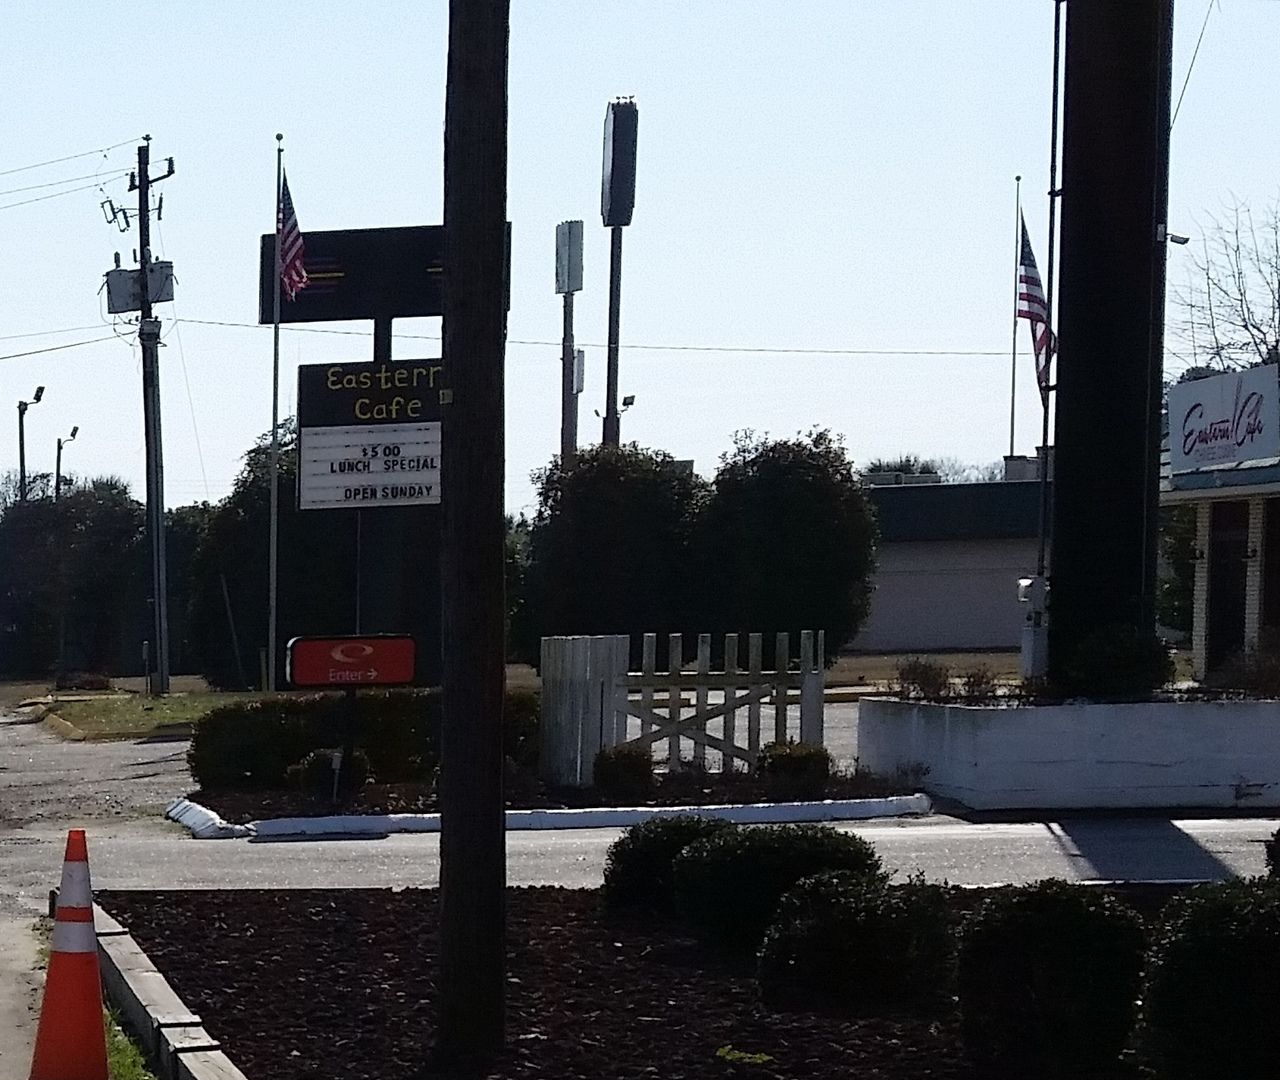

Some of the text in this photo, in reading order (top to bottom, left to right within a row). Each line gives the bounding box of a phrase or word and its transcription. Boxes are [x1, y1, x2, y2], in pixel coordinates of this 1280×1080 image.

[355, 397, 422, 419] Cafe
[330, 457, 438, 474] LUNCH SPECIAL
[344, 485, 433, 500] OPEN SUNDAY
[329, 669, 364, 681] Enter
